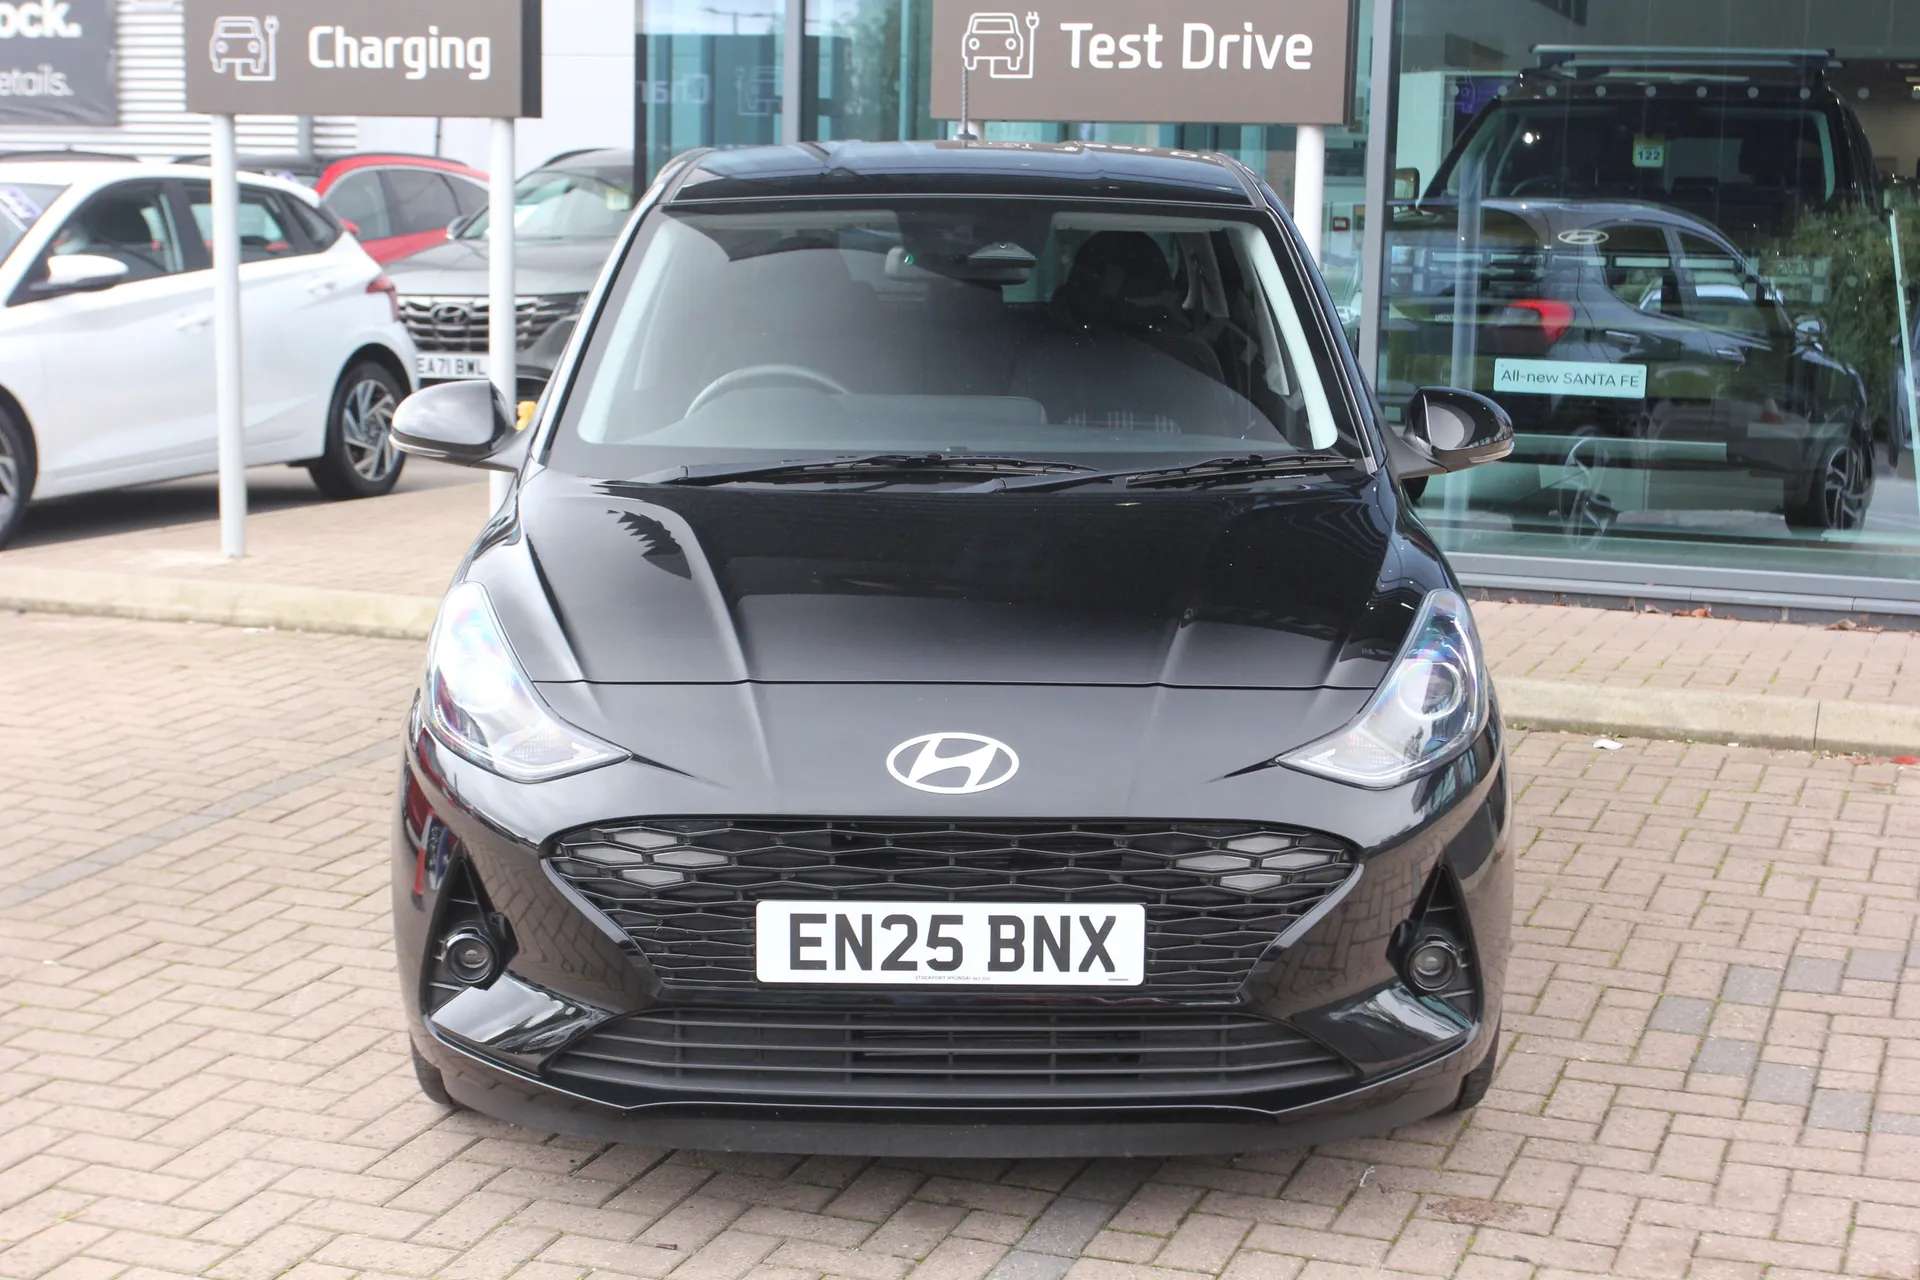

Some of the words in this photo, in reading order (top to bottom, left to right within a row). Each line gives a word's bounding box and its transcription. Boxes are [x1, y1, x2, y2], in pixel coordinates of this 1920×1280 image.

[308, 25, 491, 80] Charging
[1060, 23, 1163, 69] Test
[1182, 22, 1313, 70] Drive
[1501, 369, 1558, 384] All-new
[1563, 372, 1616, 387] SANTA
[1620, 375, 1640, 388] FE
[790, 913, 964, 971] EN25
[987, 915, 1117, 973] BNX
